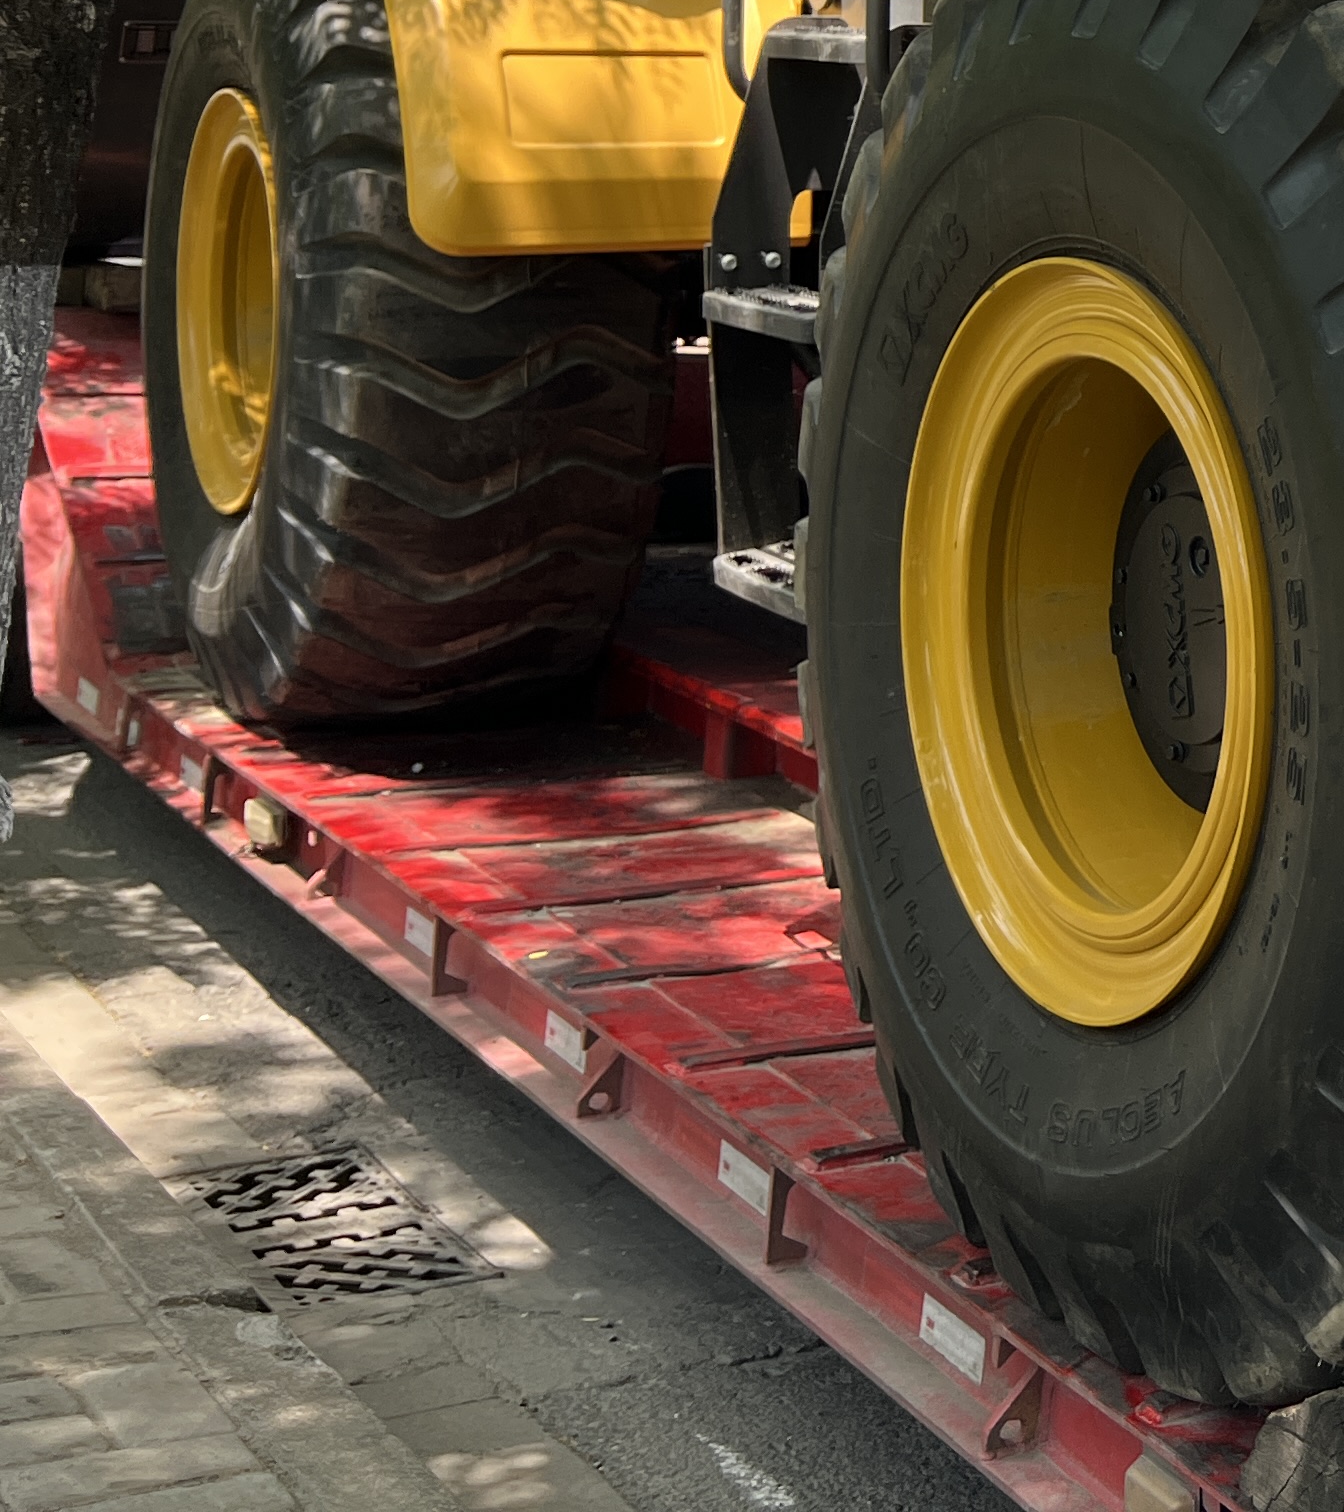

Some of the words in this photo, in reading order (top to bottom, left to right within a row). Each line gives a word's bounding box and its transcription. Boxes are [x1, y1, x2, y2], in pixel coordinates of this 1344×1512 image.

[893, 211, 969, 348] XCMG
[1161, 522, 1191, 673] XCMG
[1257, 415, 1311, 806] 23.5-25
[859, 756, 905, 902] LTD.
[948, 1011, 1029, 1129] TYRE
[1046, 1068, 1187, 1149] AEOLUS
